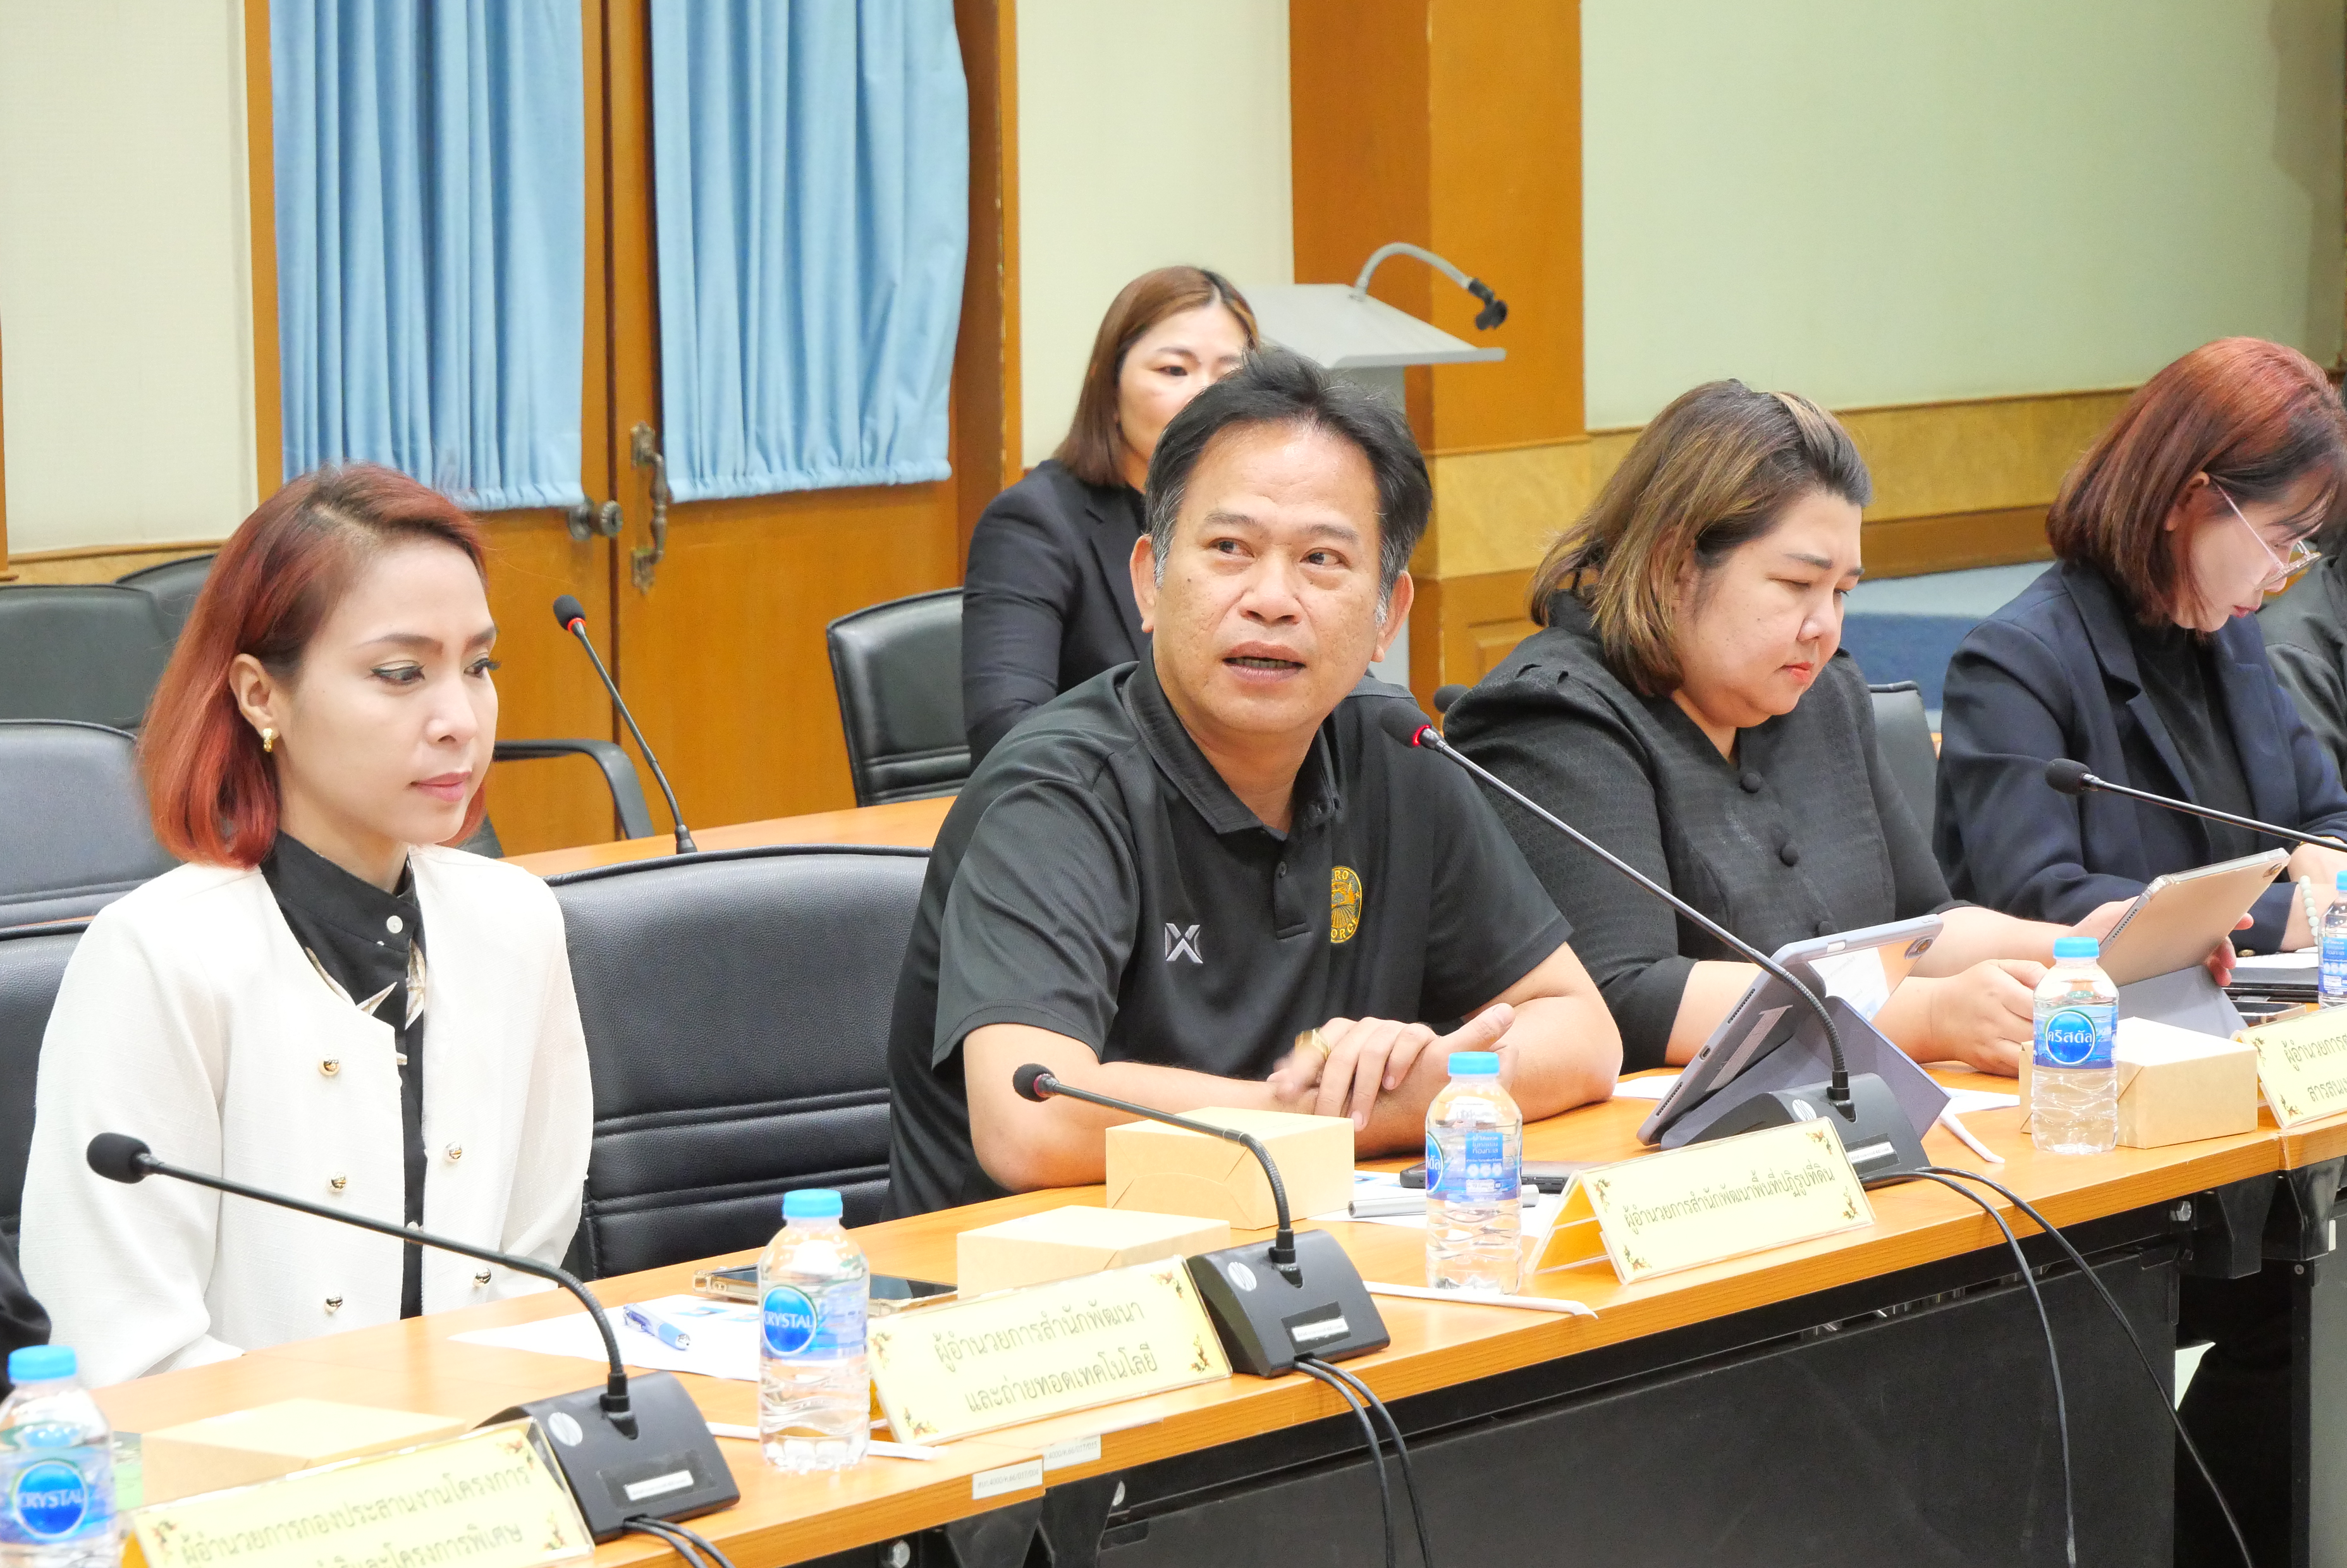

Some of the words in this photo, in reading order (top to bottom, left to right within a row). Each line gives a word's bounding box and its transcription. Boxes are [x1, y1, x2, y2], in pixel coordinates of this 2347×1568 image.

[1332, 870, 1349, 881] RO
[1330, 915, 1358, 939] ORCE
[2048, 1029, 2093, 1043] คริสตัล
[2307, 1077, 2347, 1102] สารสนเ
[1622, 1159, 1835, 1235] ผู้อำนวยการสำนักพัฒนาพื้นที่ปฏิรูปที่ดิน
[764, 1311, 813, 1328] CRYSTAL
[933, 1299, 1145, 1373] ผู้อำนวยการสำนักพัฒนา
[964, 1342, 1158, 1412] และถ่ายทอดเทคโนโลยี
